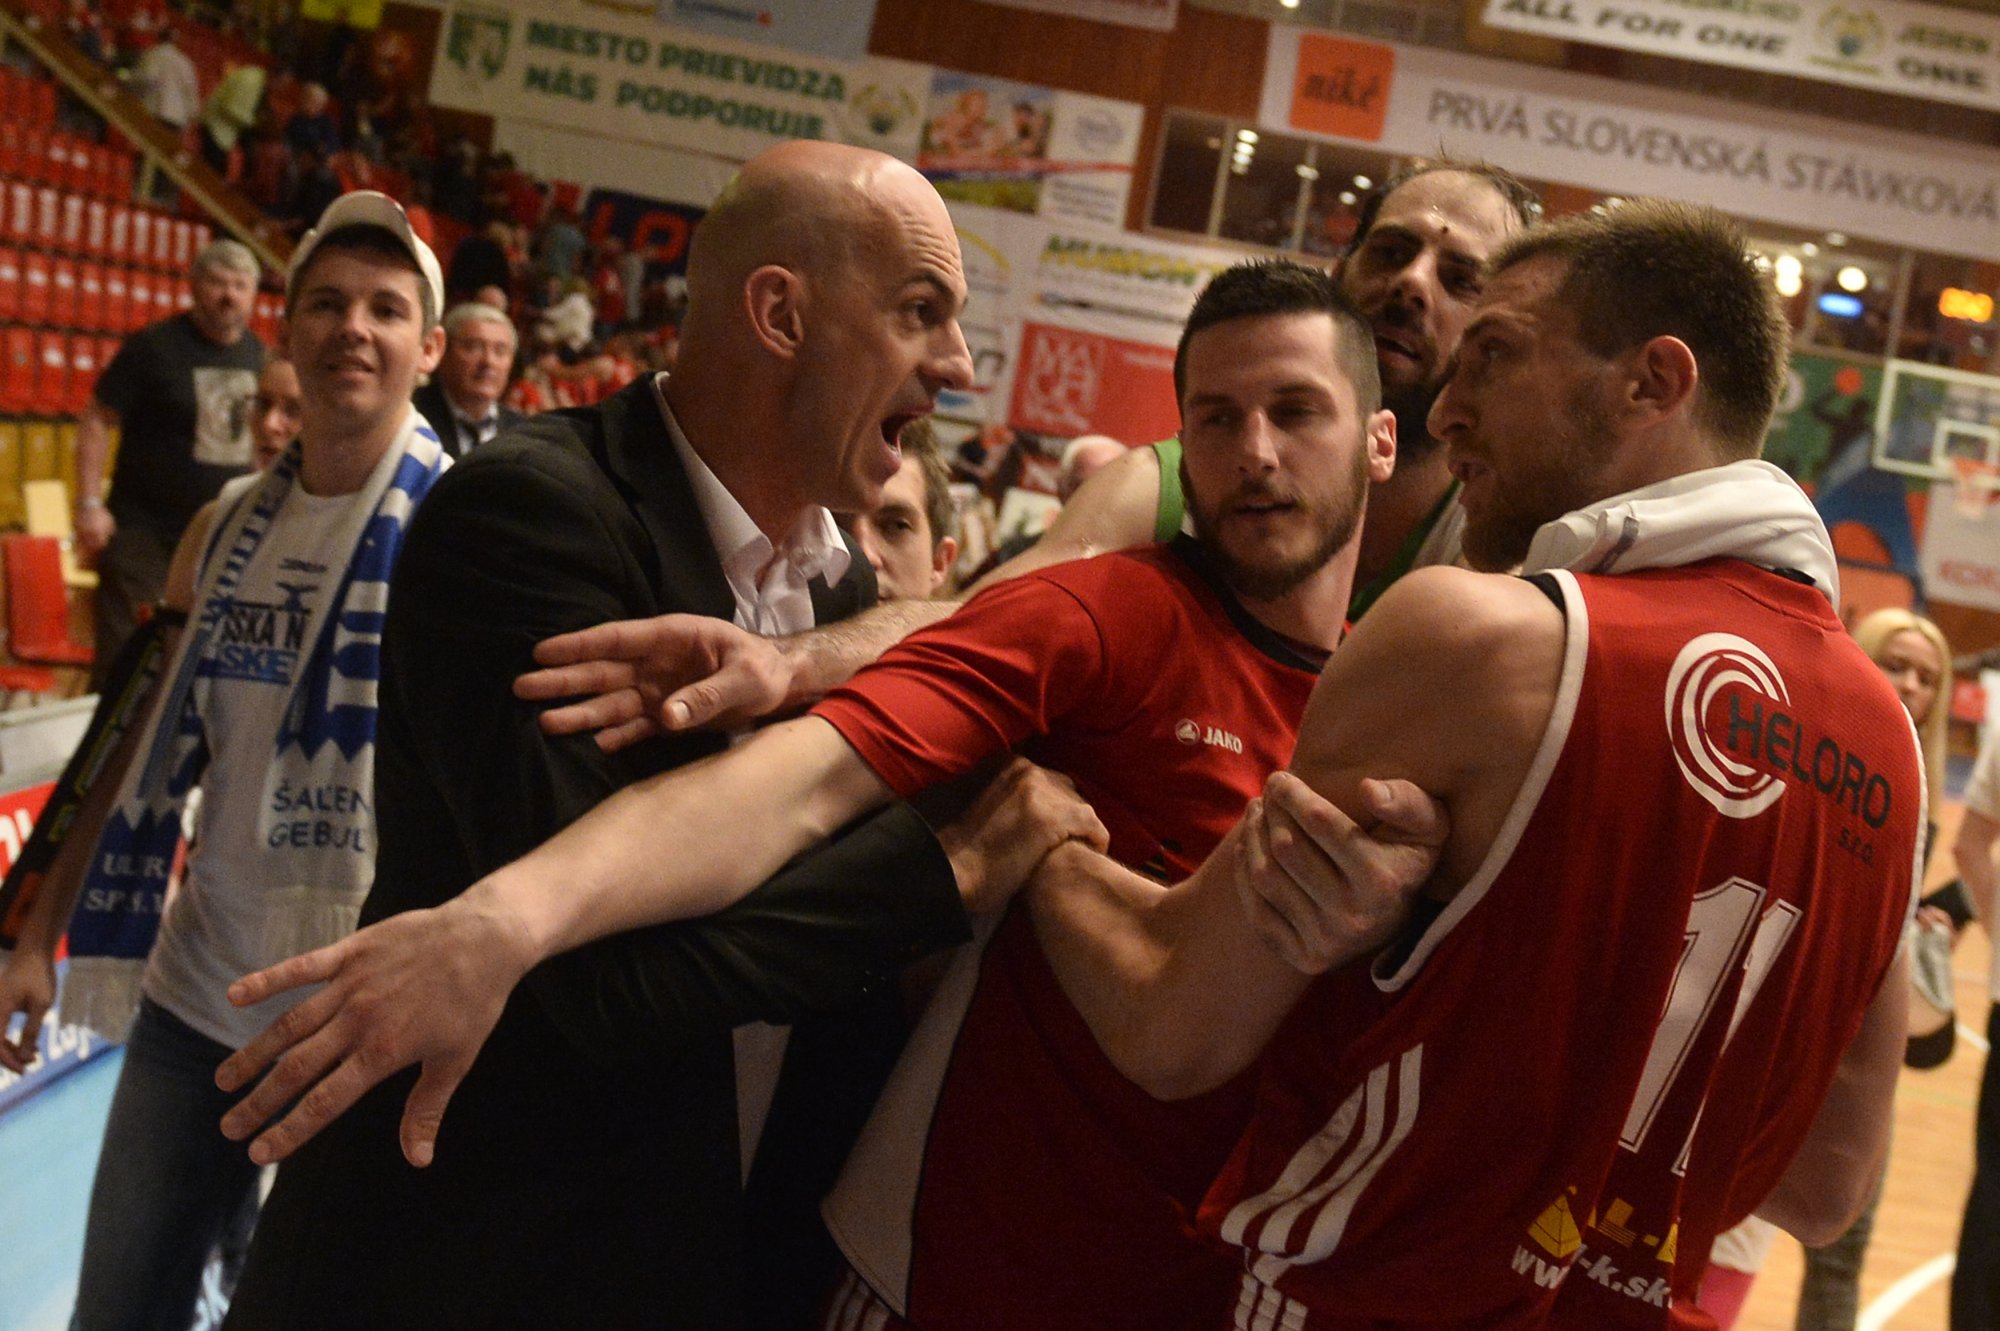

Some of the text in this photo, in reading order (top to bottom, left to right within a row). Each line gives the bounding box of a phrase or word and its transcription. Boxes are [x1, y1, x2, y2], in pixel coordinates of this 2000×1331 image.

[526, 18, 845, 101] MESTO PRIEVIDZA
[1596, 8, 1684, 38] FOR
[1697, 23, 1789, 54] ONE
[523, 62, 824, 140] NÁS PODPORUJE
[1898, 56, 1984, 87] ONE
[1427, 86, 2000, 222] PRVÁ SLOVENSKÁ STÁVKOVÁ
[1203, 726, 1243, 755] JAKO
[1727, 694, 1892, 830] HELORO
